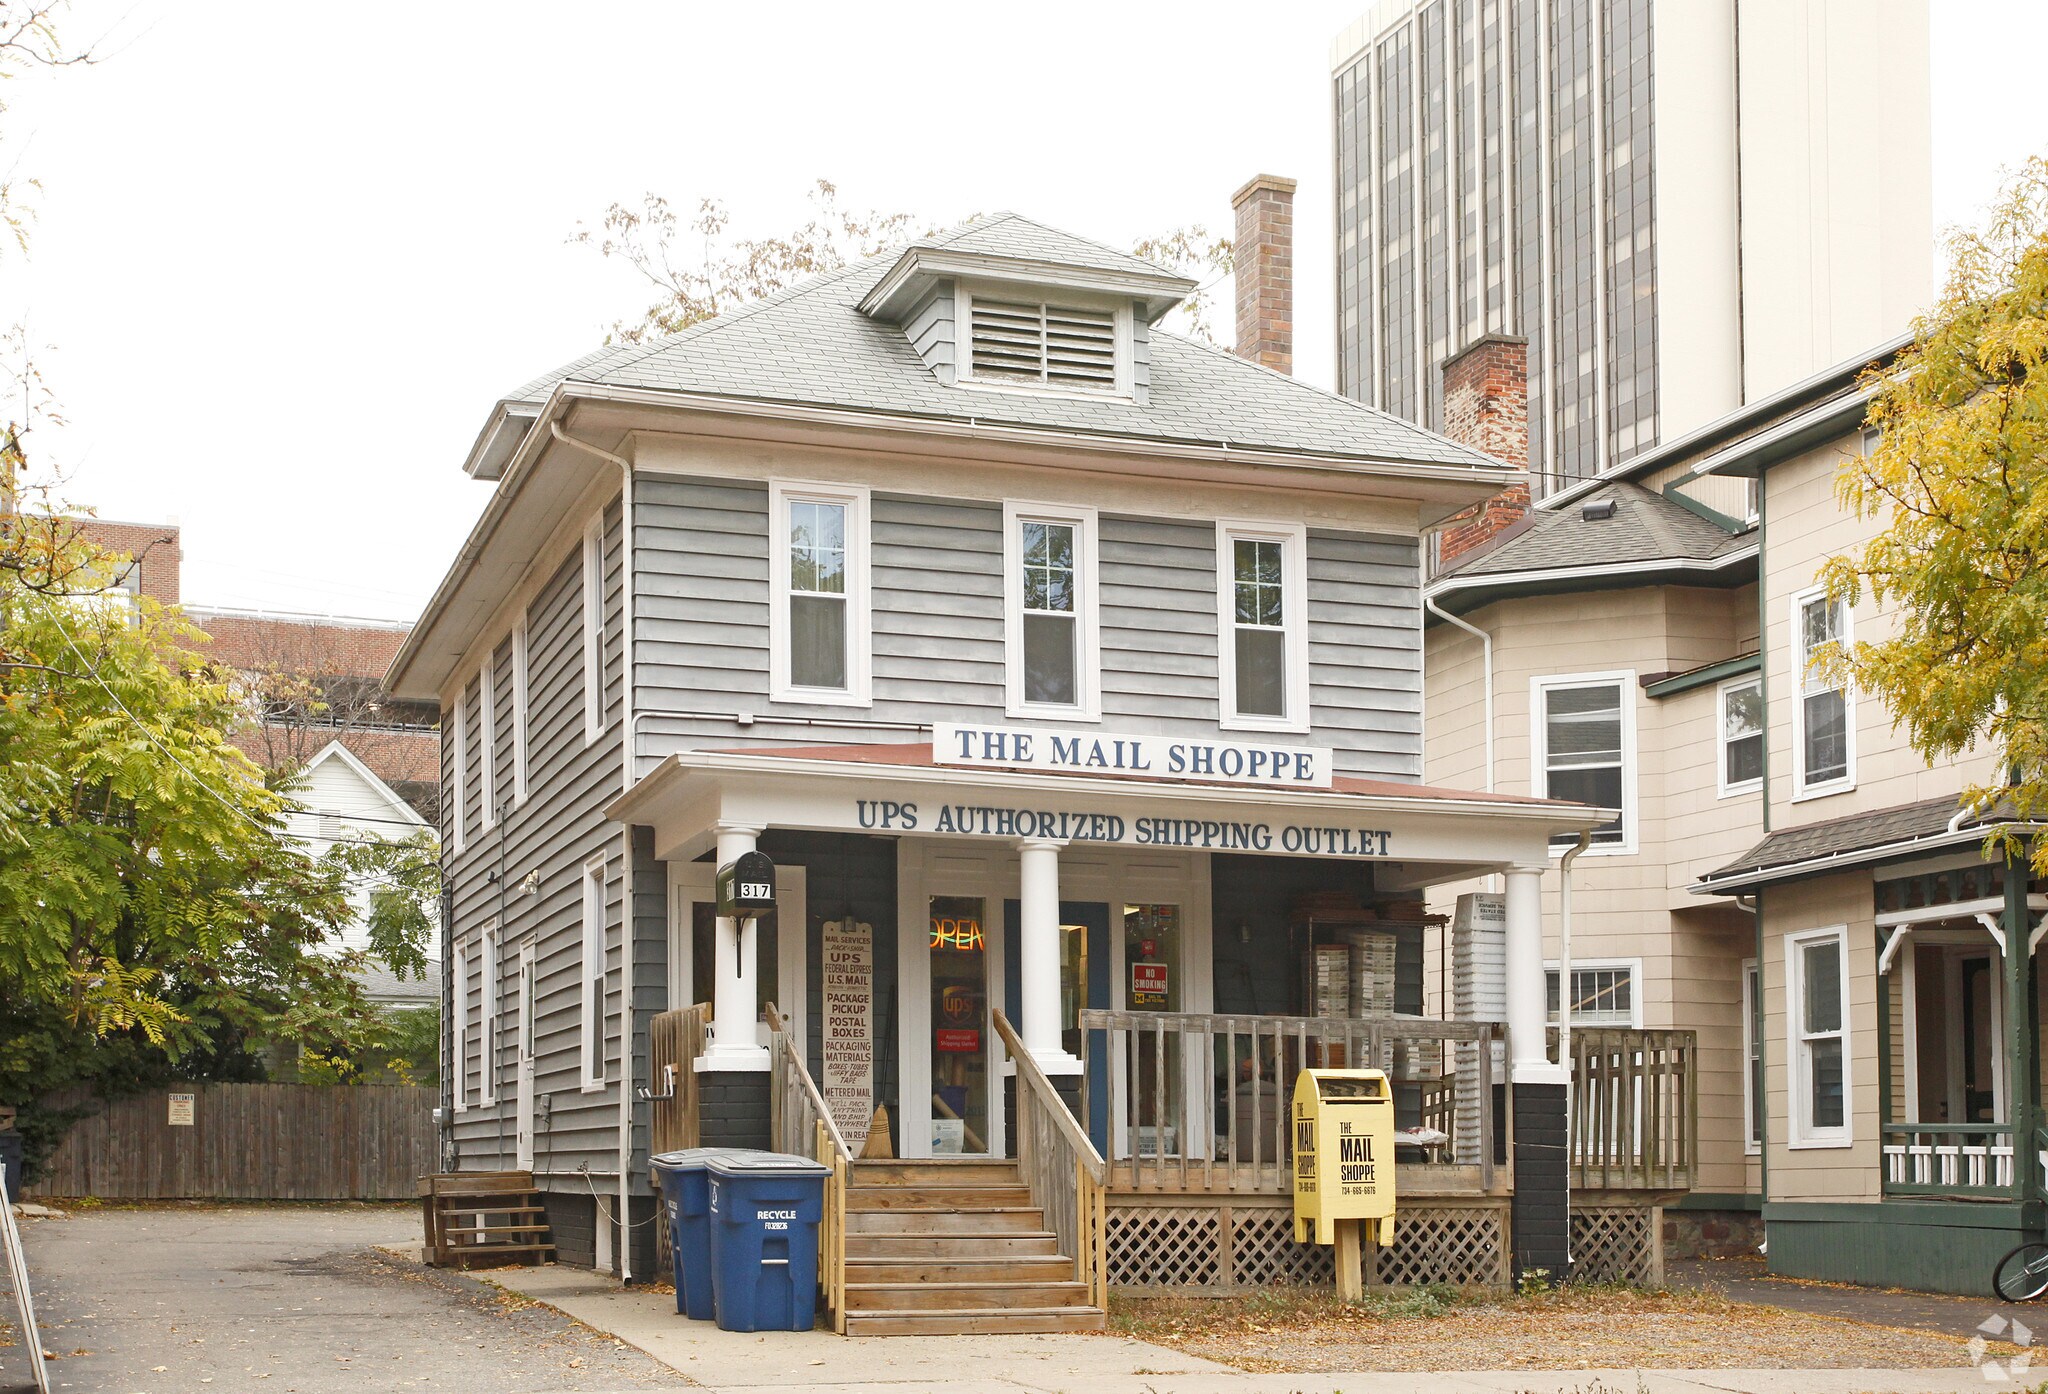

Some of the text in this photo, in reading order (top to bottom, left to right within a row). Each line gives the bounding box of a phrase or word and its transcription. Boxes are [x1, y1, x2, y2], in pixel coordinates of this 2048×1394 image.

[955, 729, 1314, 781] THE MAIL SHOPPE
[856, 800, 1392, 856] UPS AUTHORIZED SHIPPING OUTLET
[743, 884, 769, 898] 317
[930, 918, 985, 950] OPEN
[841, 936, 871, 944] SERVICES
[830, 953, 861, 963] UPS
[825, 963, 872, 974] FEDERAL EXPRESS
[1145, 968, 1155, 978] NO
[828, 974, 869, 985] U.S. MAIL
[1135, 979, 1166, 989] SMOKING
[827, 993, 870, 1004] PACKAGE
[832, 1004, 866, 1014] PICKUP
[945, 997, 970, 1017] ups
[829, 1017, 866, 1027] POSTAL
[832, 1028, 865, 1038] BOXES
[826, 1041, 871, 1051] PACKAGING
[826, 1052, 871, 1062] MATERIALS
[825, 1087, 871, 1097] METERED MAIL
[834, 1120, 867, 1128] NYWHERE
[1340, 1121, 1352, 1134] THE
[845, 1131, 852, 1139] IN
[1297, 1122, 1315, 1152] MAIL
[1340, 1138, 1375, 1162] MAIL
[1298, 1155, 1316, 1175] SHOPPE
[1341, 1164, 1375, 1181] SHOPPE
[757, 1210, 796, 1219] RECYCLE
